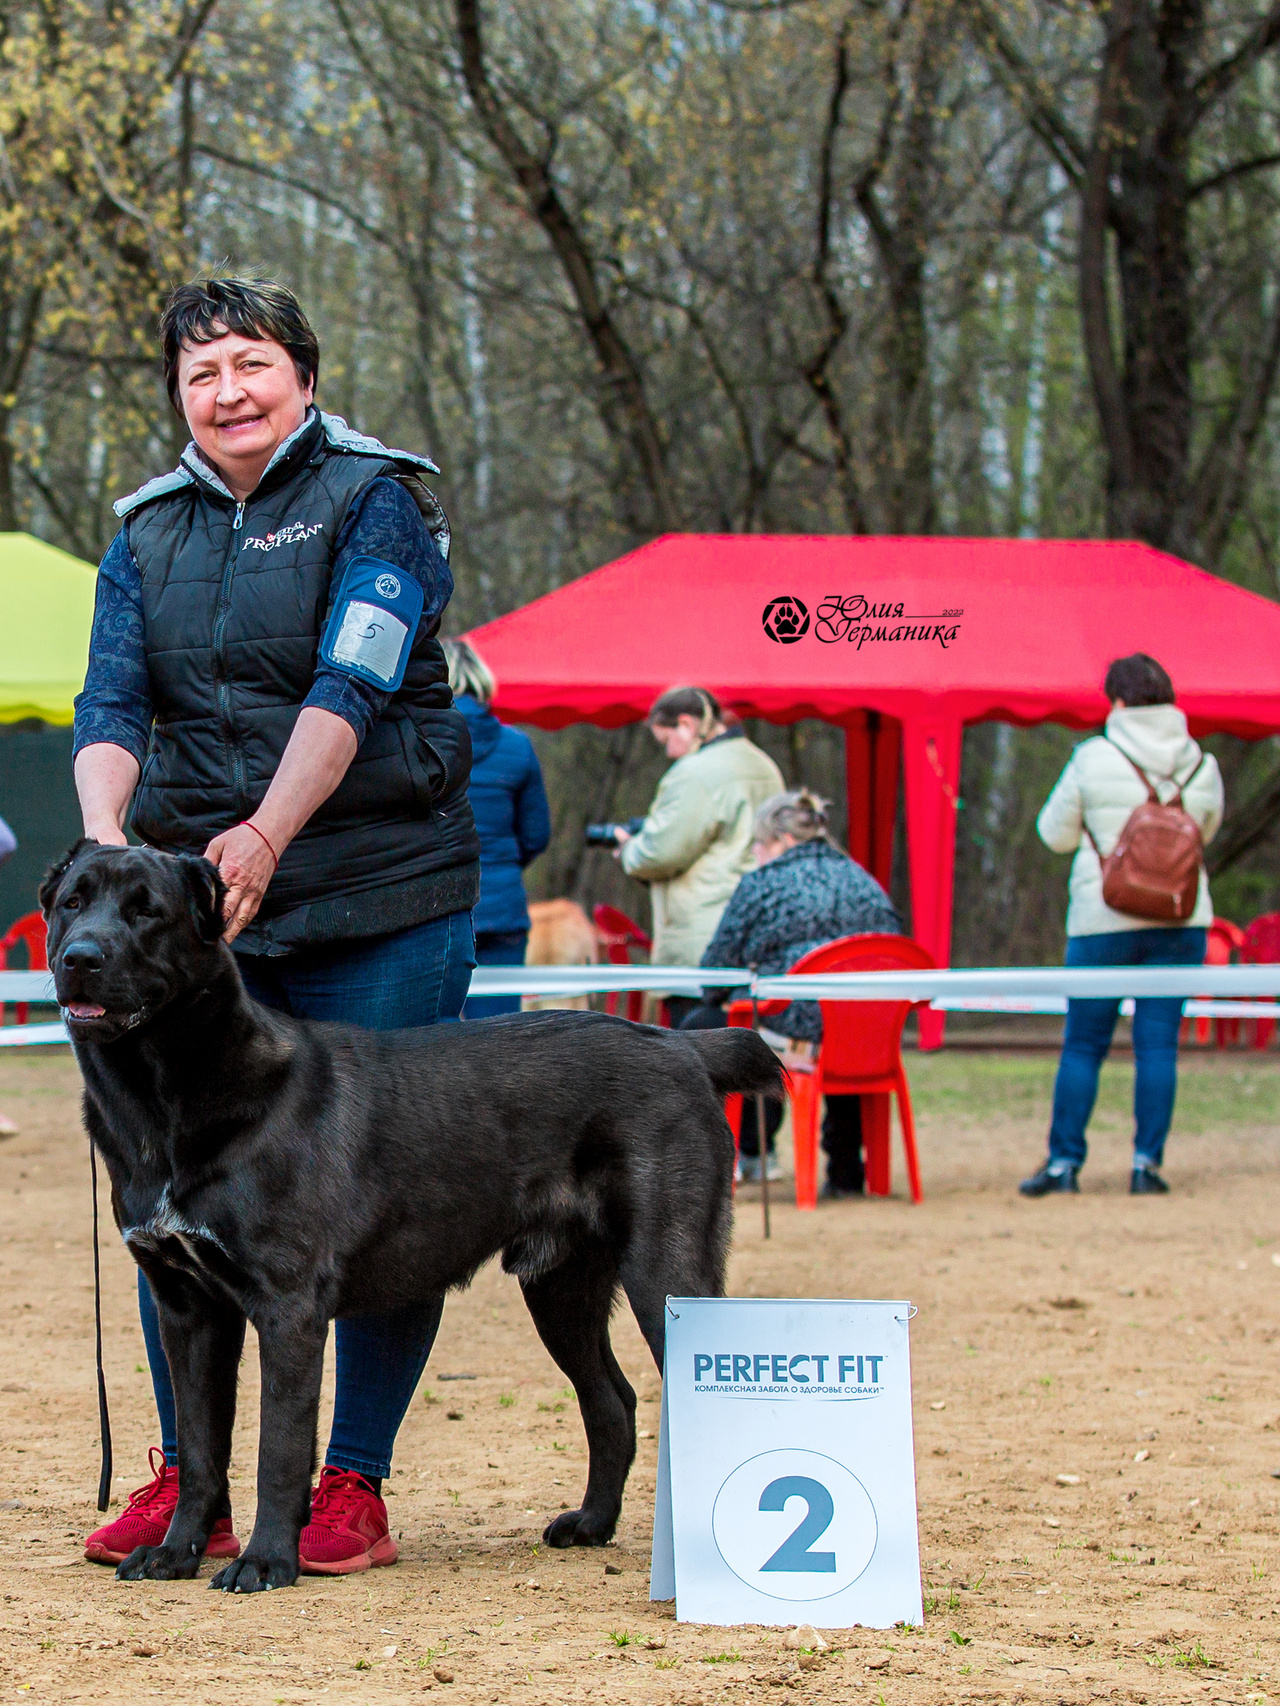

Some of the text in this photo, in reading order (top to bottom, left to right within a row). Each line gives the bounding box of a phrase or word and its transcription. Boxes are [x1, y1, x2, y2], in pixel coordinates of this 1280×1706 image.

[357, 623, 385, 639] 5
[694, 1354, 884, 1383] PERFECT FIT
[758, 1385, 789, 1393] ЗАБОТА
[800, 1386, 842, 1394] ЗДОРОВЬЕ
[758, 1475, 837, 1573] 2
